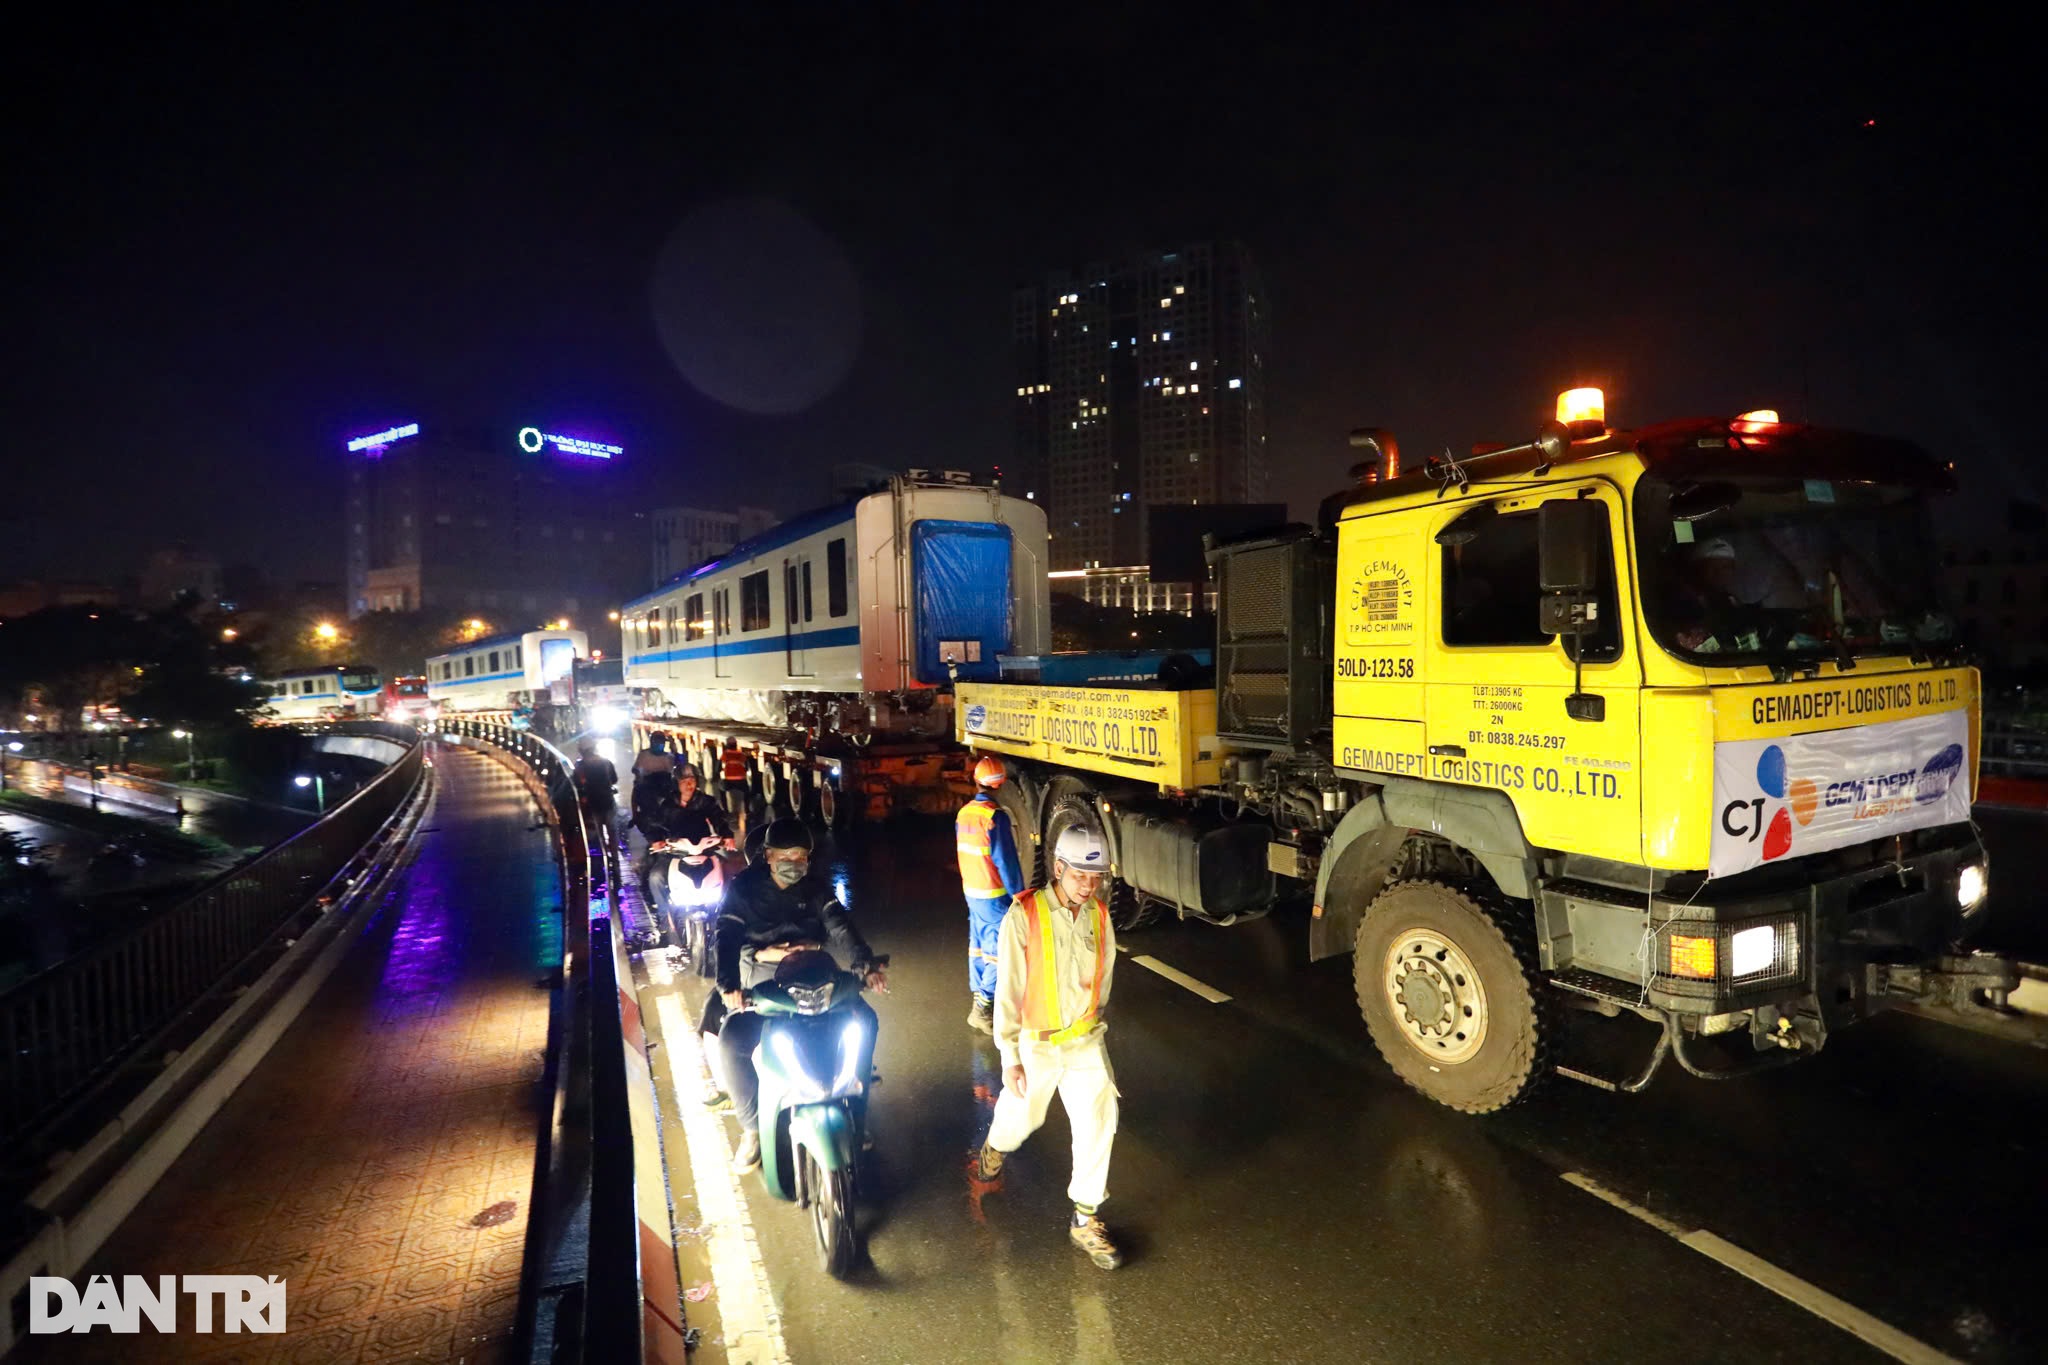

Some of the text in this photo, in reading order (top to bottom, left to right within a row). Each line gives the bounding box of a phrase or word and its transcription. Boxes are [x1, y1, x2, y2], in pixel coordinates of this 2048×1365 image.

[1364, 561, 1412, 609] GEMADEPT
[1391, 622, 1413, 632] MINH
[1513, 687, 1523, 697] KG
[1107, 707, 1151, 722] 38245192
[1473, 700, 1523, 711] TTT: 26000KG
[987, 711, 1036, 738] GEMADEPT
[1041, 716, 1097, 748] LOGISTICS
[1491, 715, 1504, 725] 2N
[1469, 730, 1566, 750] ĐT: 0838.245.297
[1343, 747, 1424, 776] GEMADEPT
[1433, 757, 1525, 789] LOGISTICS
[1825, 768, 1917, 807] GEMADEPT
[1722, 797, 1766, 843] CJ
